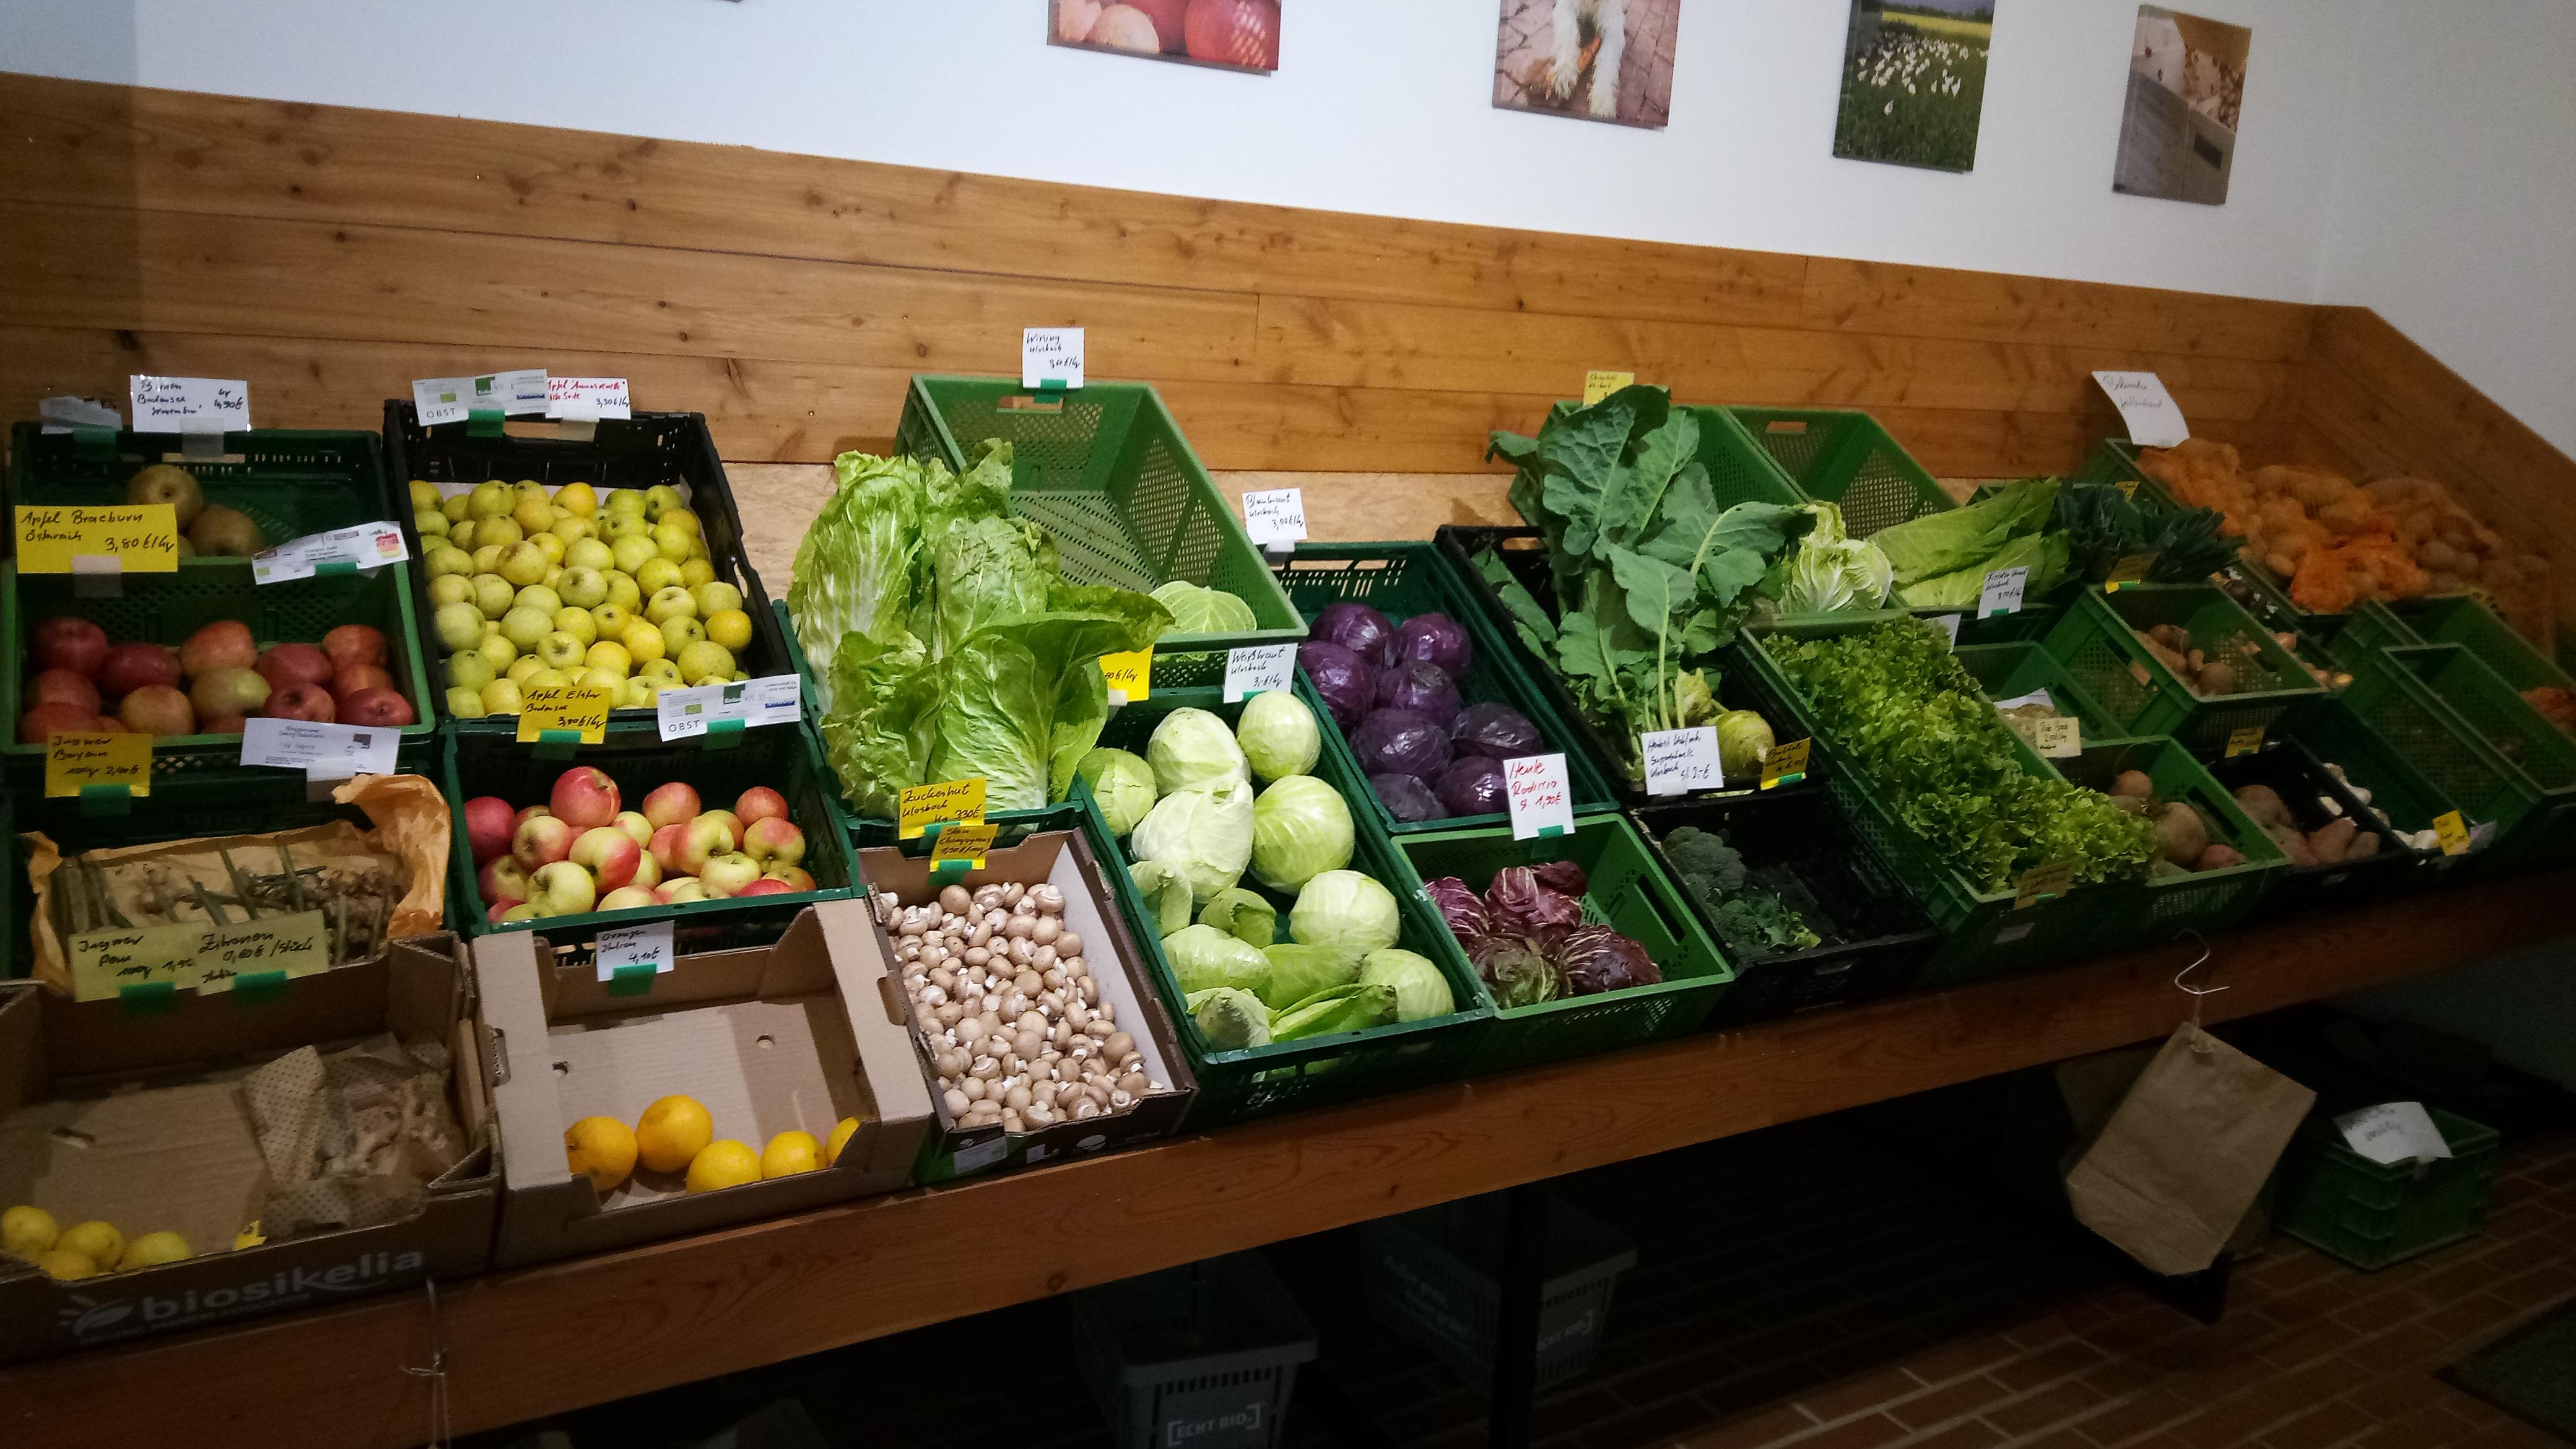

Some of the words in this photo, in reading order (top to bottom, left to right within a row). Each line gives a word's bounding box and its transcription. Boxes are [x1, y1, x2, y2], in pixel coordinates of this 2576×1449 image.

[427, 407, 456, 419] OBST
[20, 511, 61, 529] Apfel
[71, 510, 143, 524] Braeburn
[527, 689, 560, 702] Apfel
[565, 689, 601, 700] Elstar
[669, 720, 700, 732] OBST
[1510, 759, 1545, 779] Heute
[903, 783, 970, 804] Zuckerhut
[198, 932, 274, 954] Zitronen
[141, 1251, 424, 1322] biosikelia
